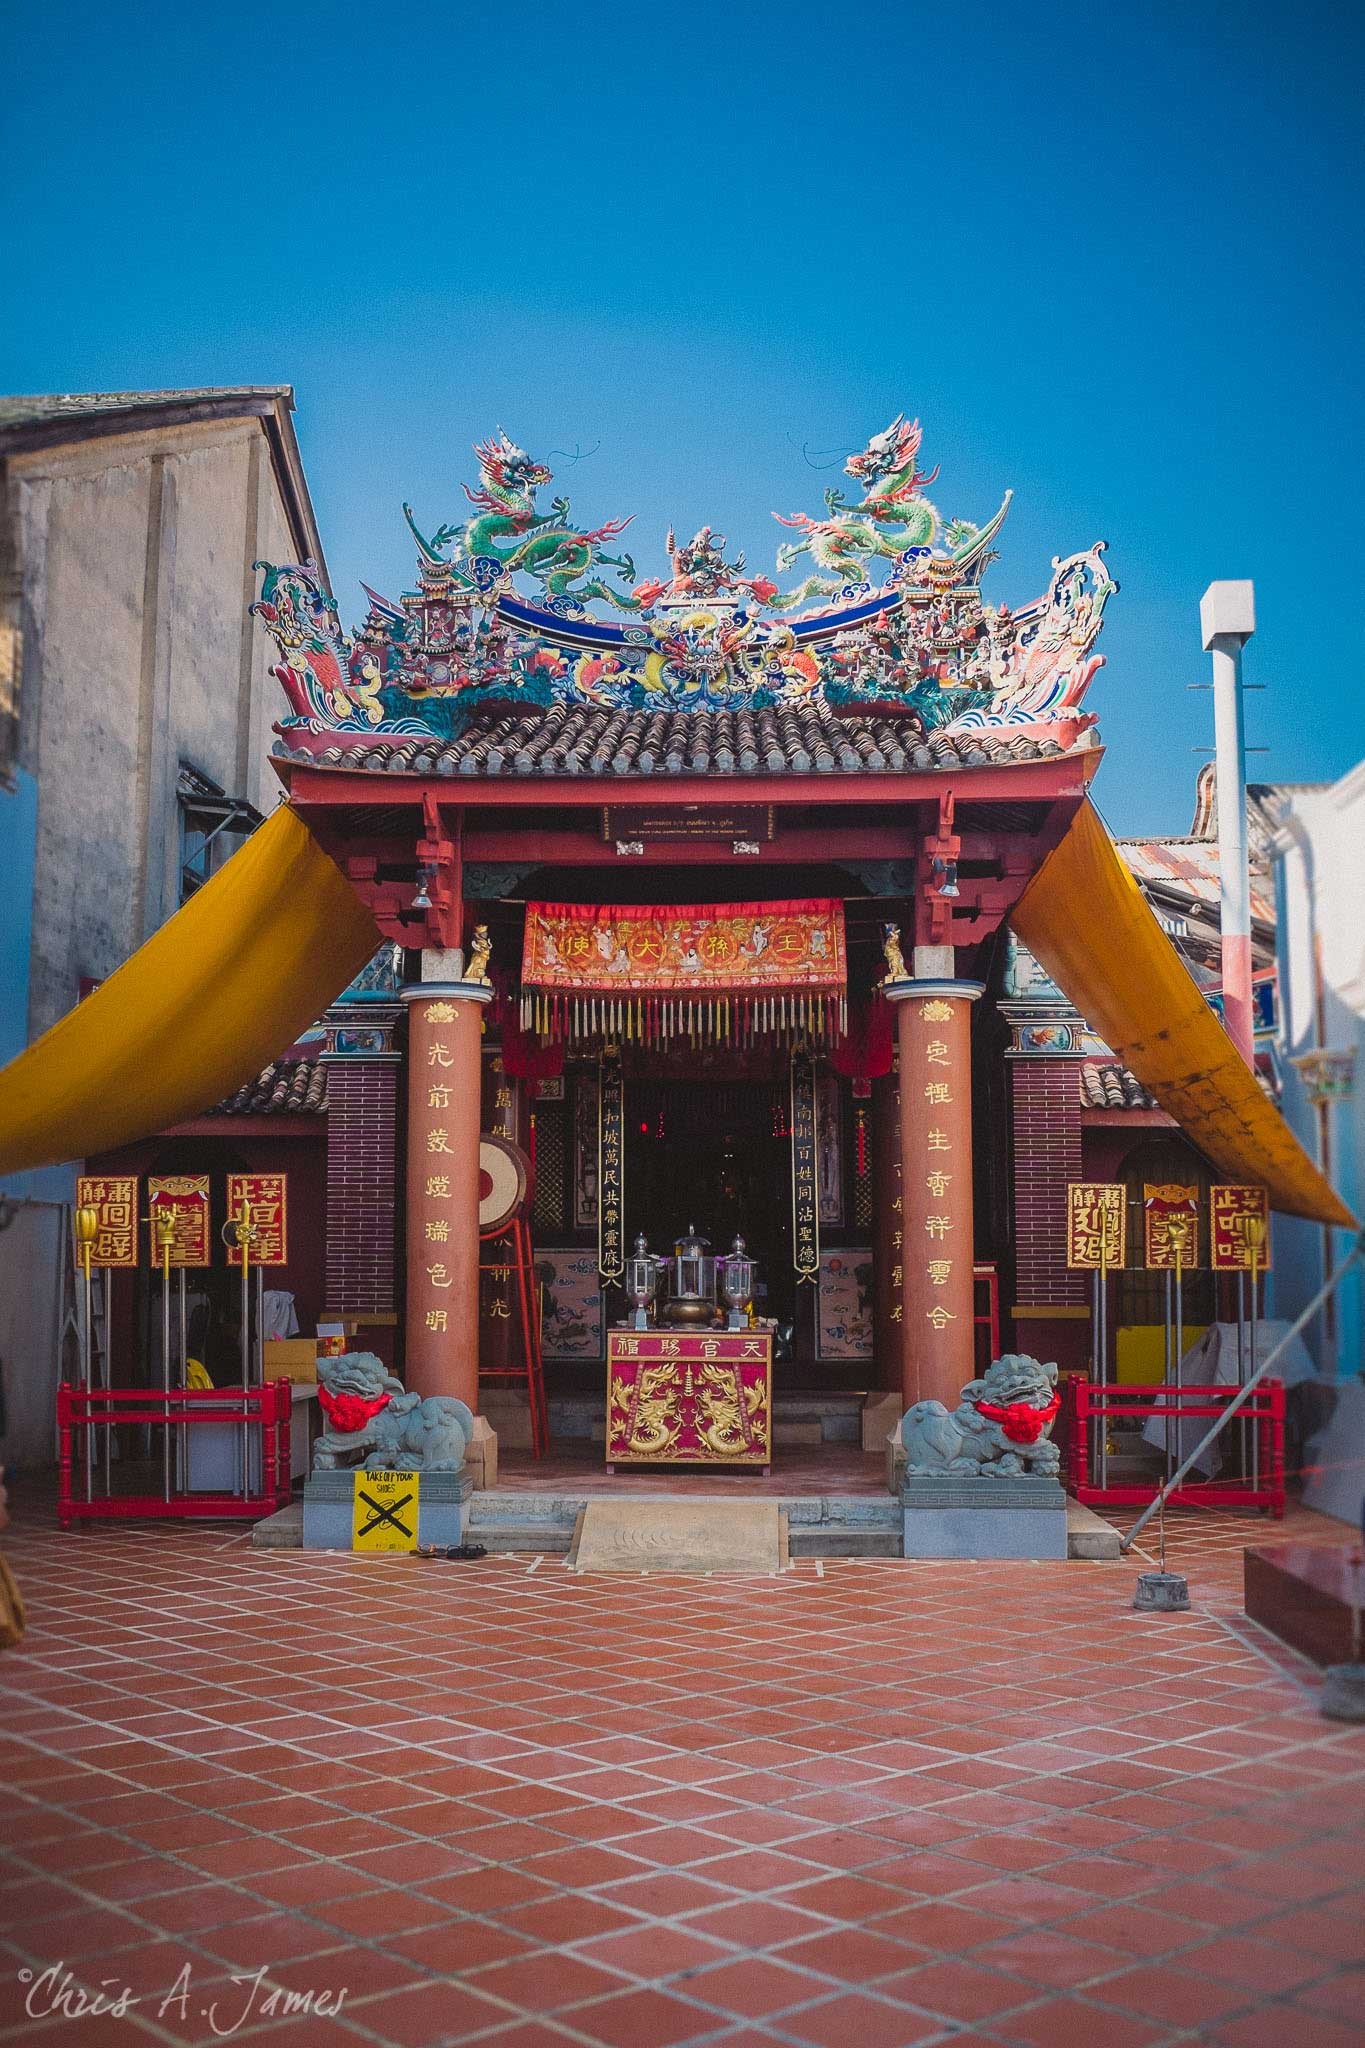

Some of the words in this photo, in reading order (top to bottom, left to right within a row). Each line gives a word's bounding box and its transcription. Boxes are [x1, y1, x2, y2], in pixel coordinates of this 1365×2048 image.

[617, 1338, 763, 1358] 天官賜福
[365, 1471, 383, 1482] TAKE
[384, 1471, 395, 1483] OFF
[396, 1471, 414, 1482] YOUR
[376, 1484, 396, 1494] SHOES
